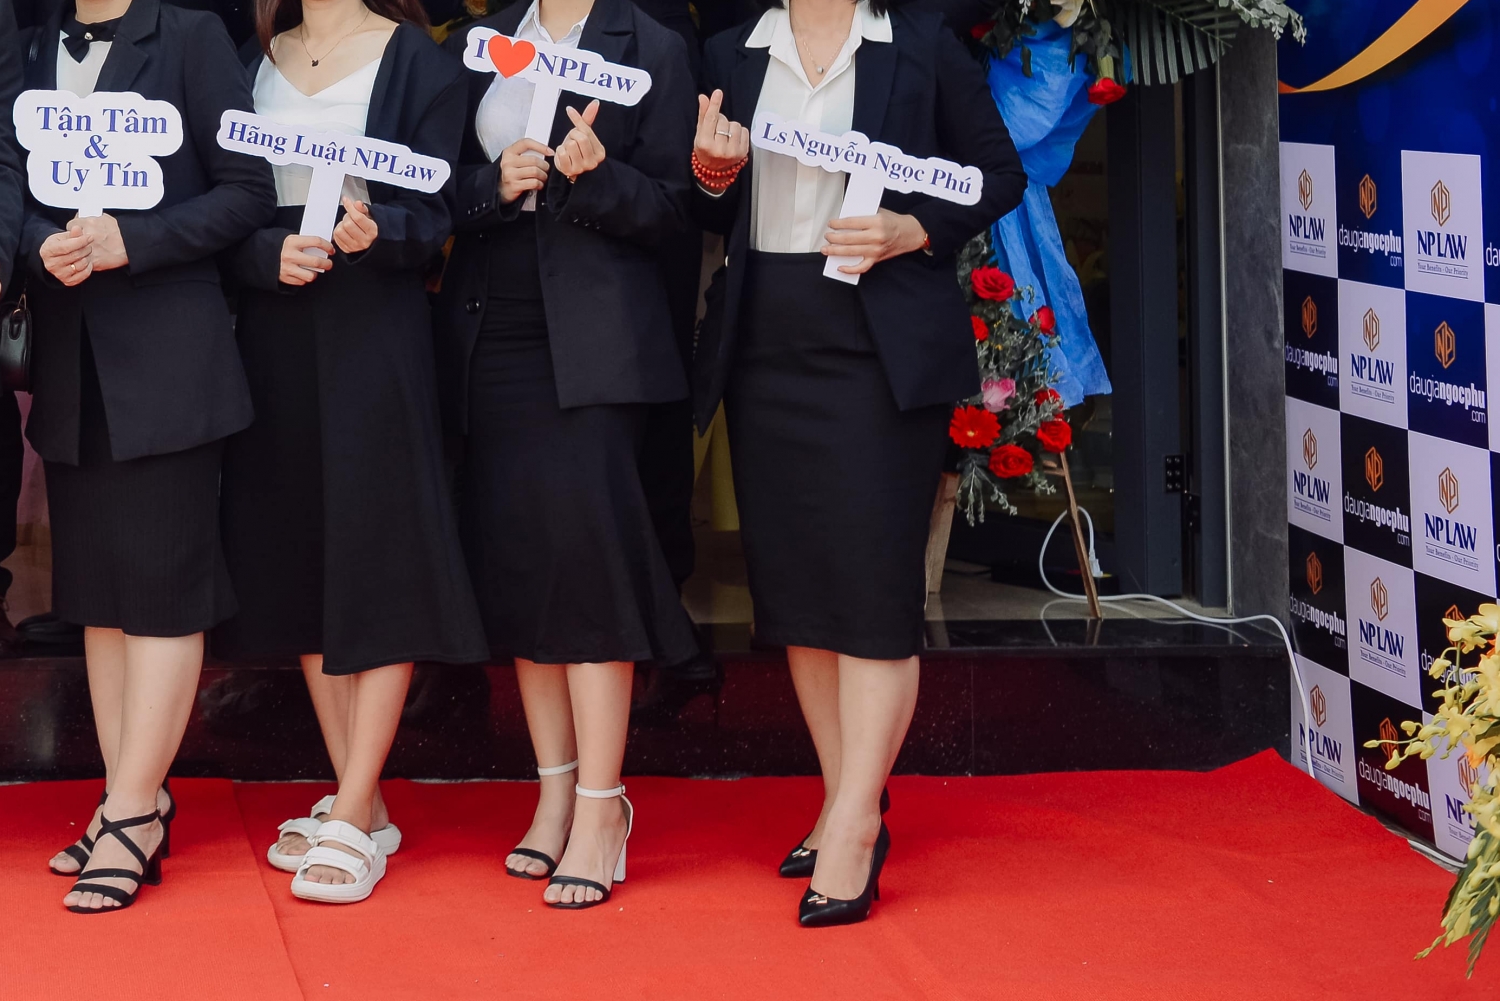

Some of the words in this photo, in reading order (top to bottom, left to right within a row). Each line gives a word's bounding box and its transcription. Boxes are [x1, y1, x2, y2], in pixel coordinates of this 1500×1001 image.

[473, 38, 486, 59] I
[533, 51, 638, 94] NPLaw
[36, 105, 92, 138] Tận
[102, 107, 168, 134] Tâm
[84, 134, 109, 159] &
[227, 120, 287, 155] Hãng
[292, 133, 346, 163] Luật
[352, 149, 438, 183] NPLaw
[761, 122, 788, 144] Ls
[790, 130, 867, 166] Nguyễn
[873, 152, 924, 183] Ngọc
[929, 167, 972, 195] Phú
[51, 160, 90, 192] Uy
[99, 161, 149, 188] Tín
